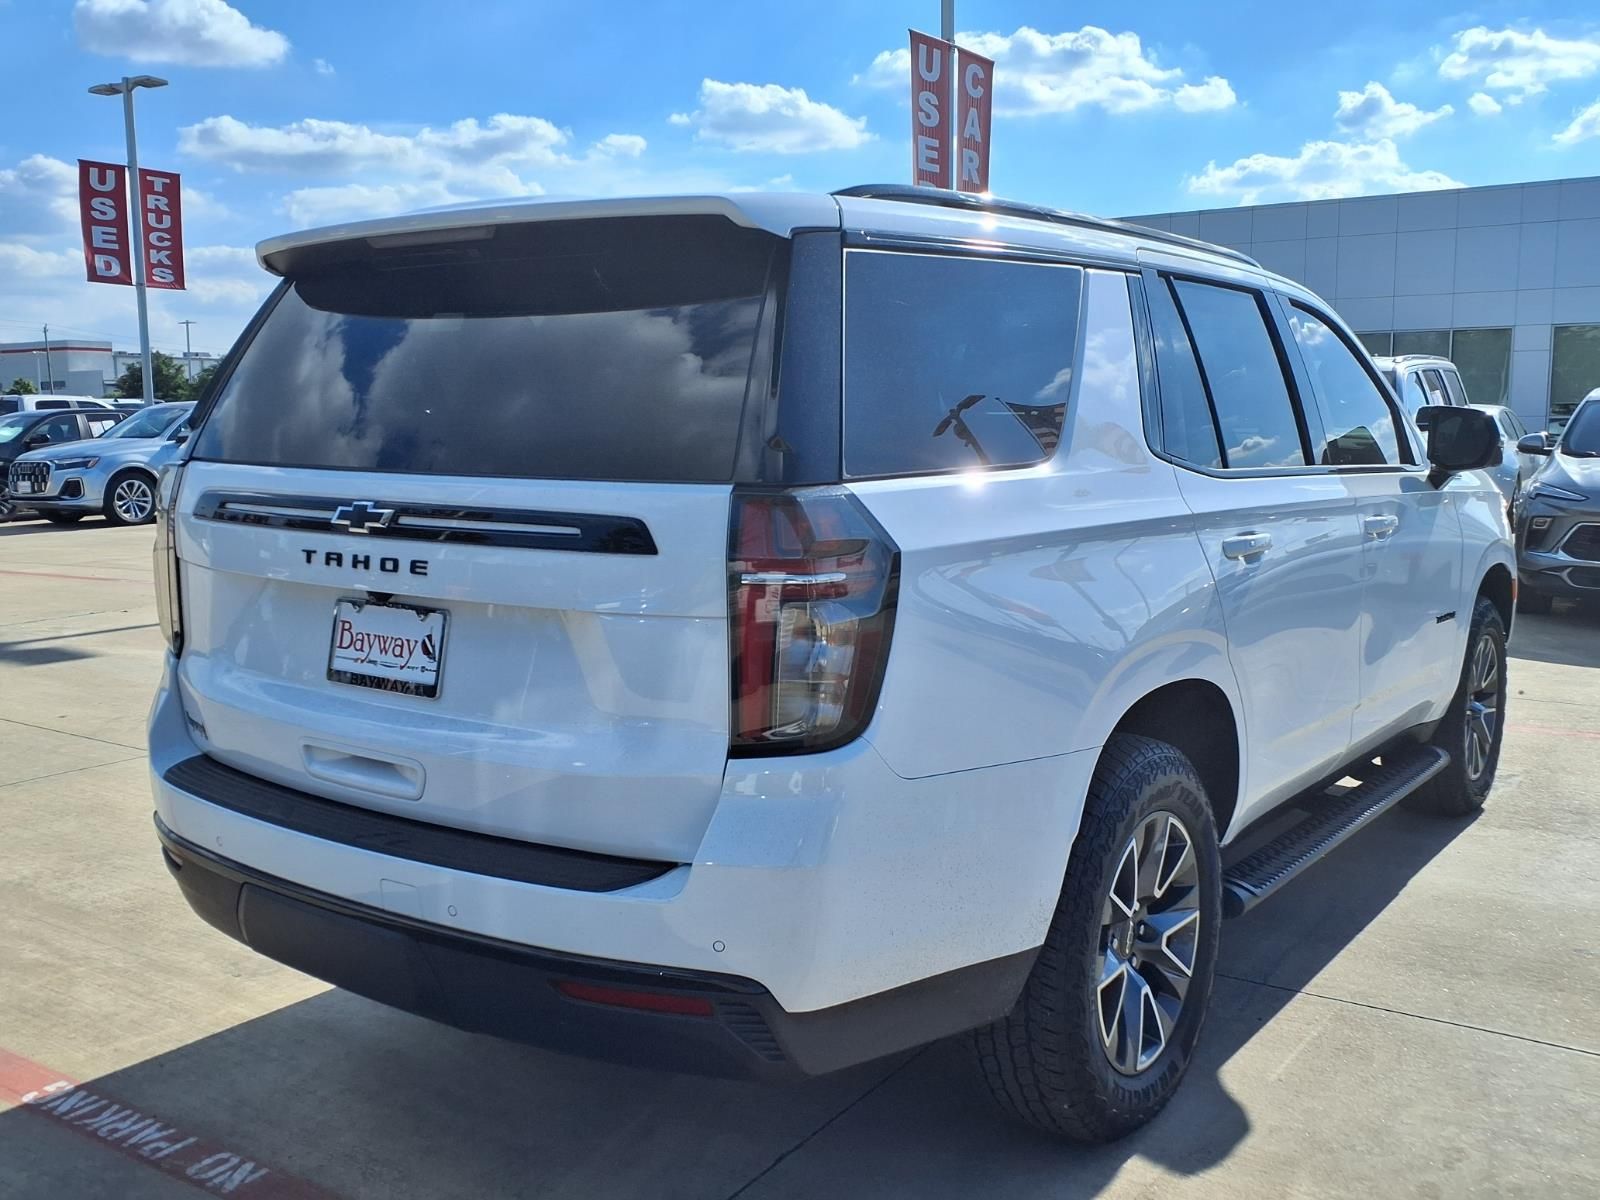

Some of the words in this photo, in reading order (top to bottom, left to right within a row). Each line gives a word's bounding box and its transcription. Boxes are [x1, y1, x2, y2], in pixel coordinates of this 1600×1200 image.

[918, 43, 941, 189] USE
[963, 63, 985, 185] CAR
[89, 167, 121, 277] USED
[146, 175, 175, 283] TRUCKS
[301, 549, 429, 576] TAHOE
[336, 619, 419, 670] Bayway
[22, 1080, 199, 1160] PARKING
[186, 1152, 270, 1193] NO
